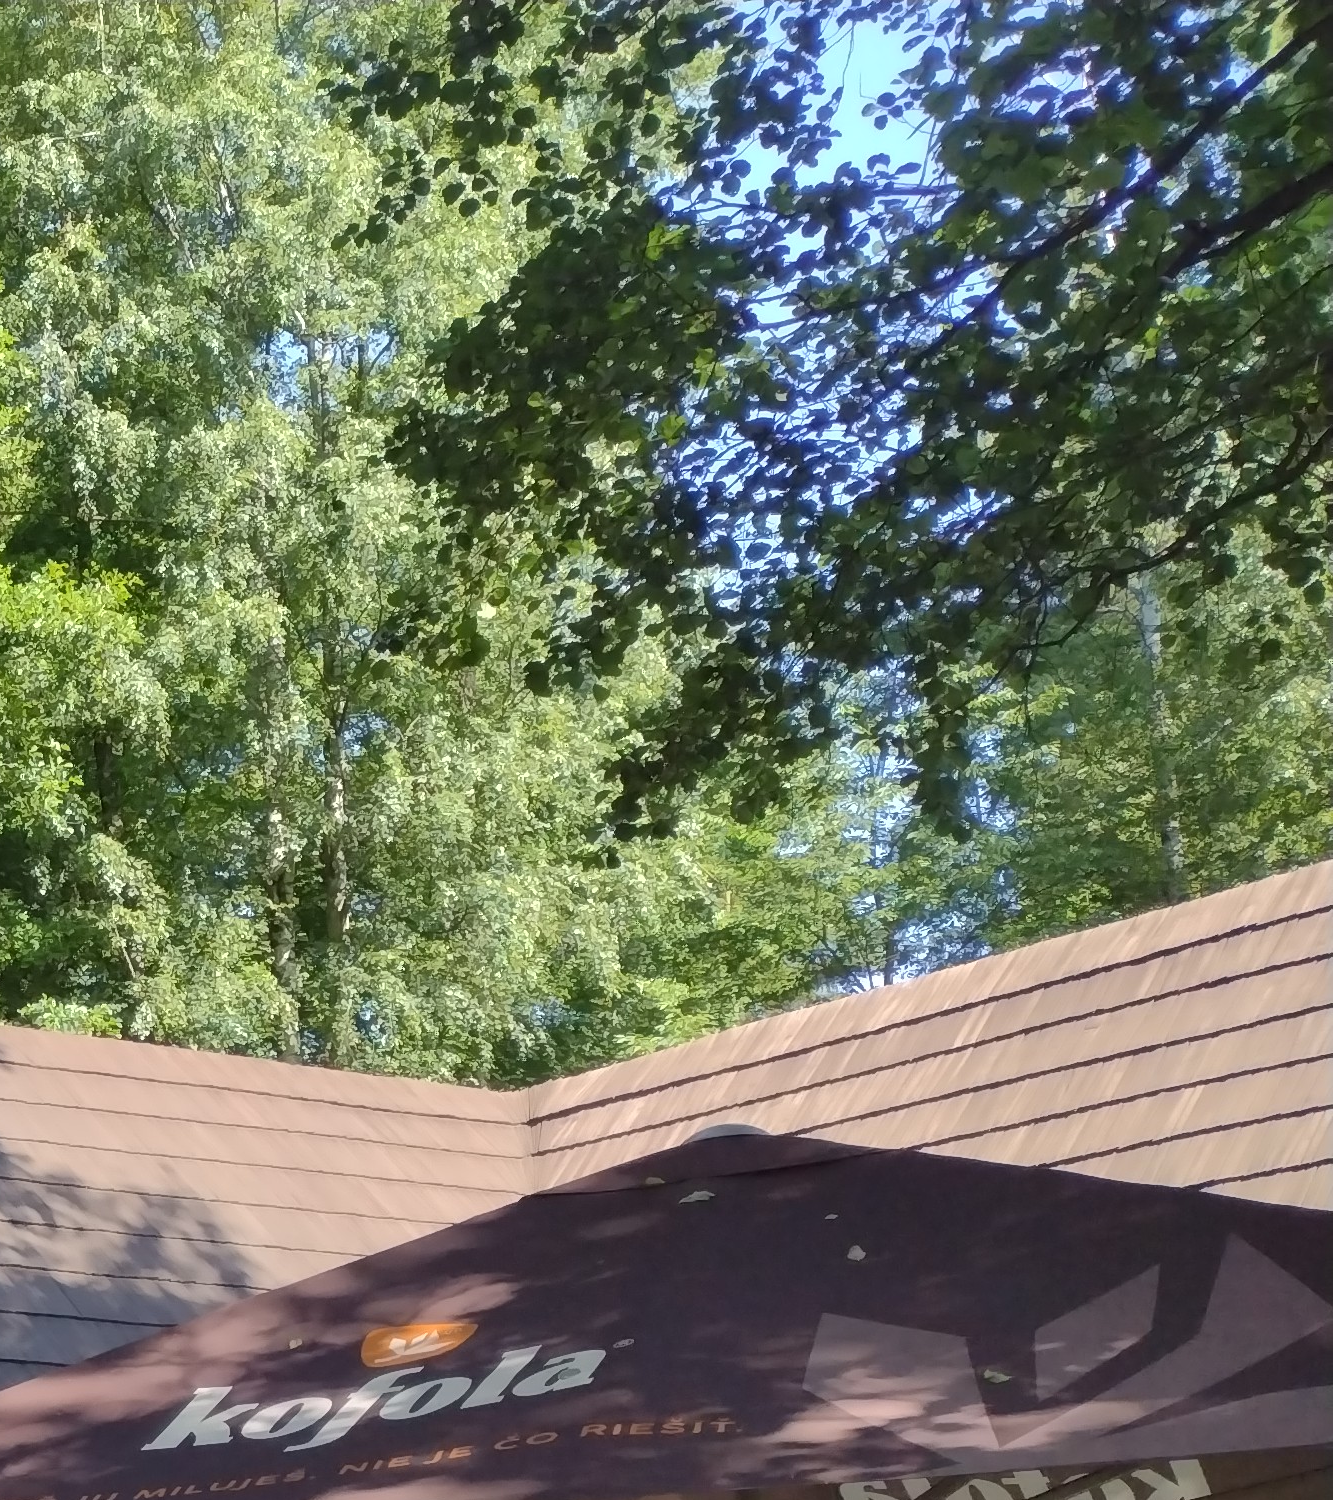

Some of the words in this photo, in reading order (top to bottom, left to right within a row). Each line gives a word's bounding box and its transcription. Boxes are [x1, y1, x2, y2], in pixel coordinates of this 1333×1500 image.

[141, 1345, 606, 1452] kofola
[338, 1455, 412, 1476] NIE
[422, 1445, 476, 1466] JE
[493, 1430, 559, 1451] ČO
